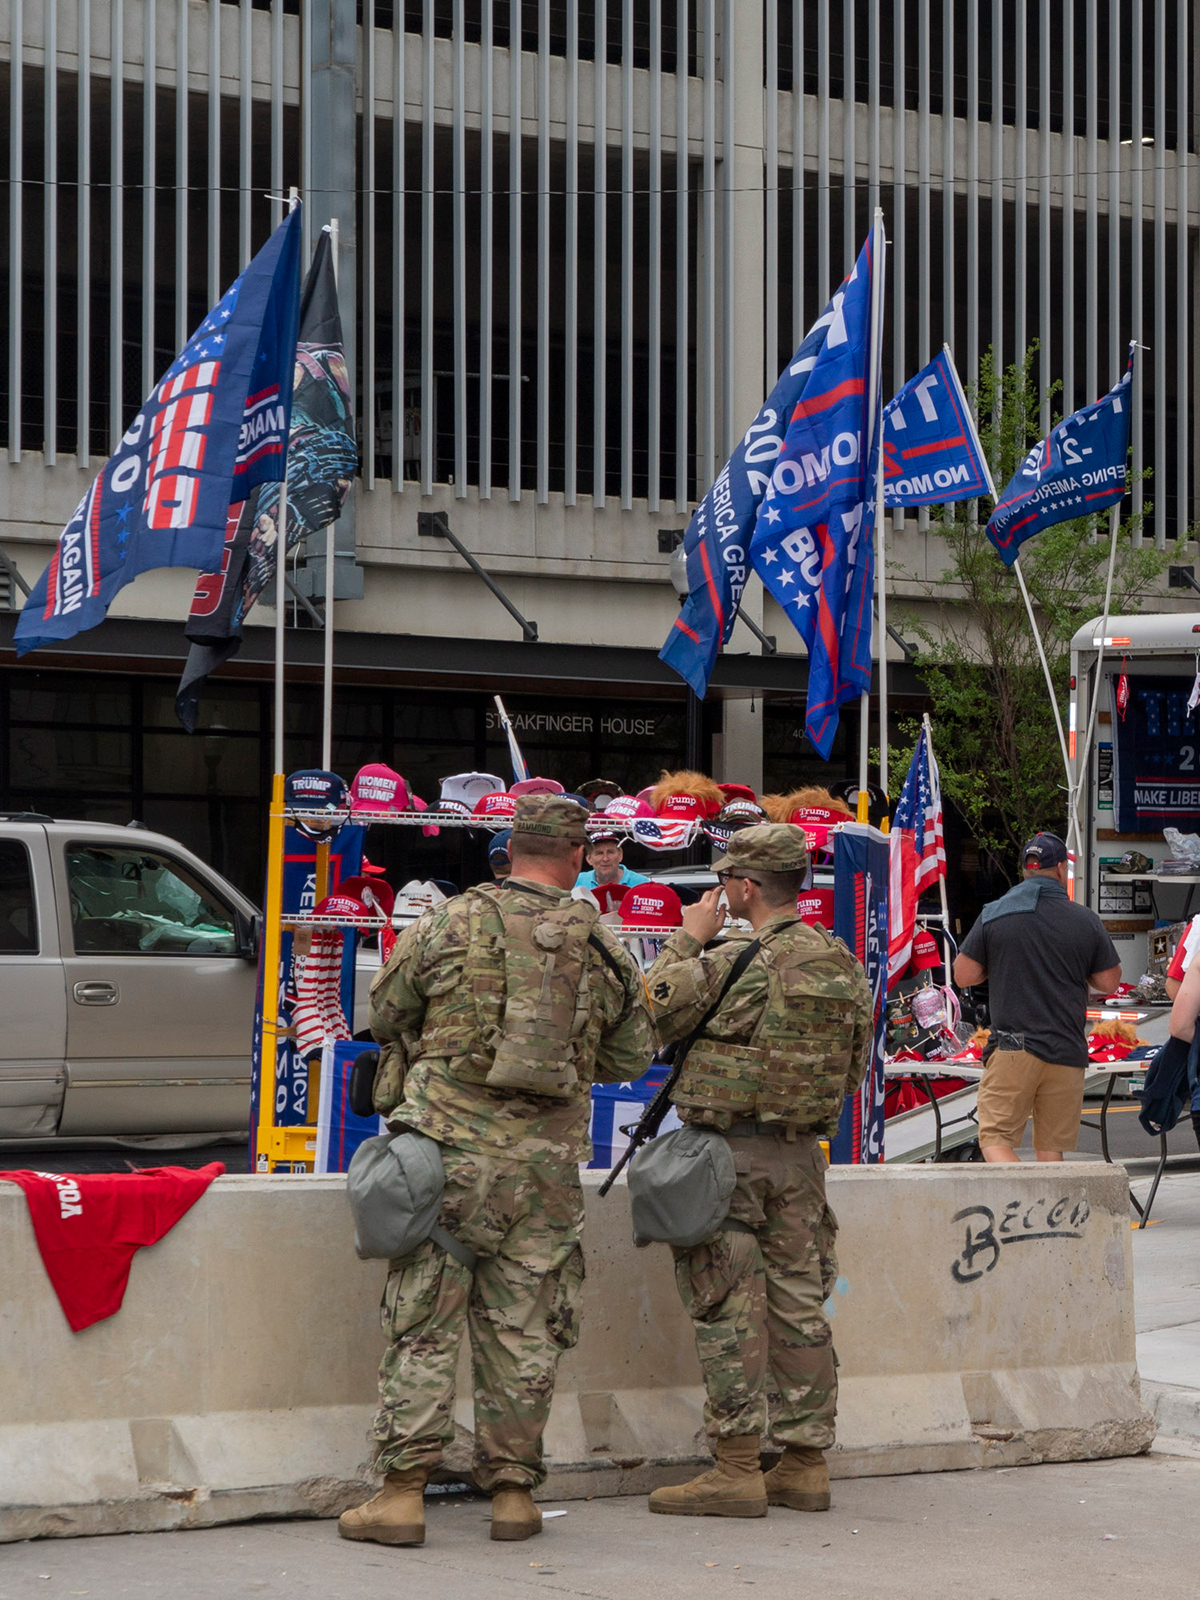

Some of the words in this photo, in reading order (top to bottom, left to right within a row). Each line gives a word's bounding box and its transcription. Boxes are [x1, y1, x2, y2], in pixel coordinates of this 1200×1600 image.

[61, 531, 83, 616] AGAIN
[485, 712, 594, 732] STEAKFINGER
[600, 717, 655, 735] HOUSE
[292, 779, 331, 791] TRUMP
[359, 775, 397, 790] WOMEN
[358, 788, 395, 802] TRUMP
[667, 795, 697, 807] Trump
[1134, 789, 1166, 805] MAKE
[724, 802, 763, 814] TRUMP
[799, 807, 831, 818] Trump
[328, 897, 360, 911] Trump
[632, 895, 664, 910] Trump
[797, 898, 822, 910] rump
